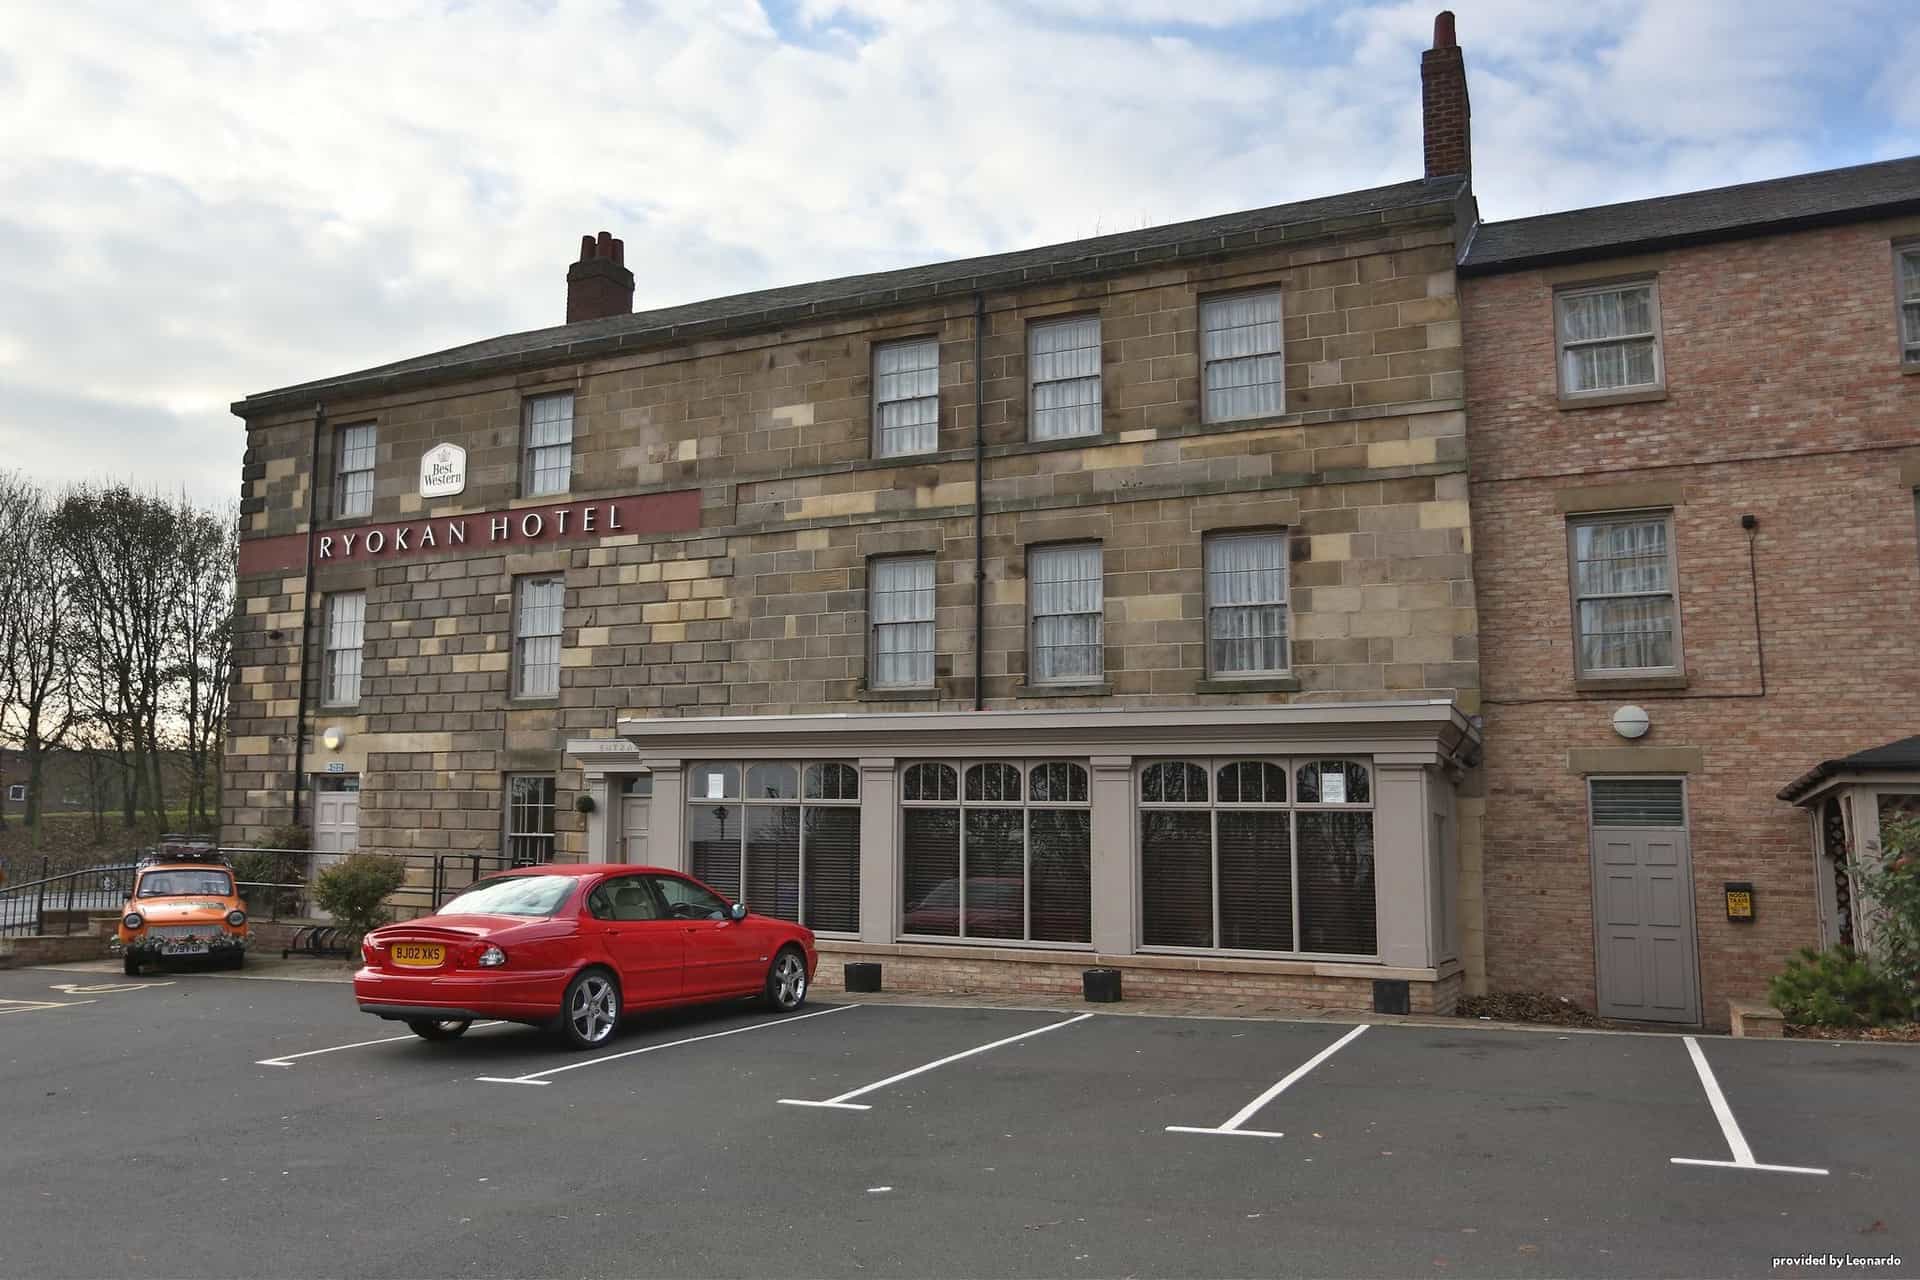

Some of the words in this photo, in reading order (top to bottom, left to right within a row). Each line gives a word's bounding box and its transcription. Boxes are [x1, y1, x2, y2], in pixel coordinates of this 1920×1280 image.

[433, 463, 452, 475] Best
[425, 473, 461, 486] Western
[320, 521, 464, 558] RYOKAN
[491, 505, 621, 541] HOTEL
[396, 947, 420, 959] BJ02
[422, 947, 440, 960] XKS
